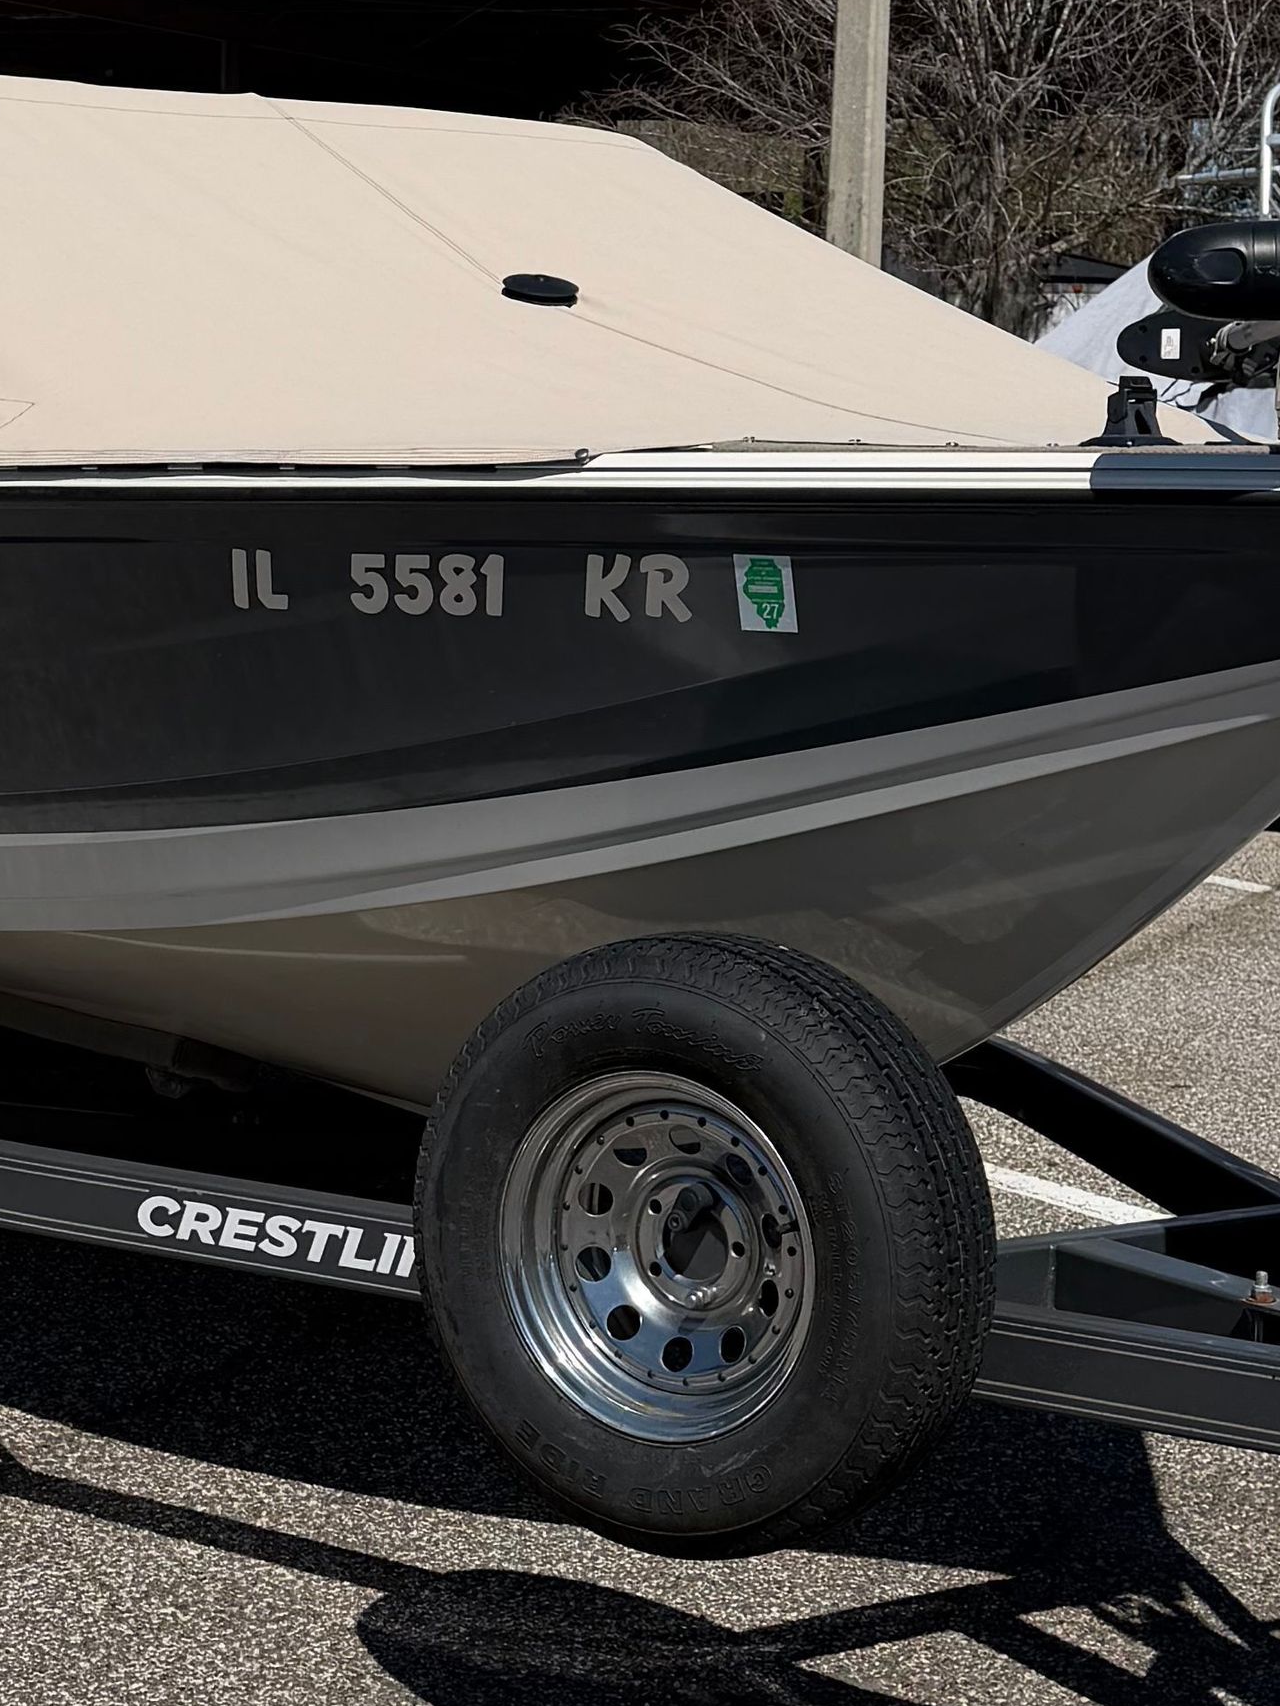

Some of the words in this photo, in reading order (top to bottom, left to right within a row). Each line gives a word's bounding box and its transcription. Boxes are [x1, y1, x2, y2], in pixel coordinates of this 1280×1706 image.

[231, 548, 289, 610] IL
[350, 553, 505, 616] 5581
[584, 553, 693, 623] KR
[762, 603, 779, 620] 27
